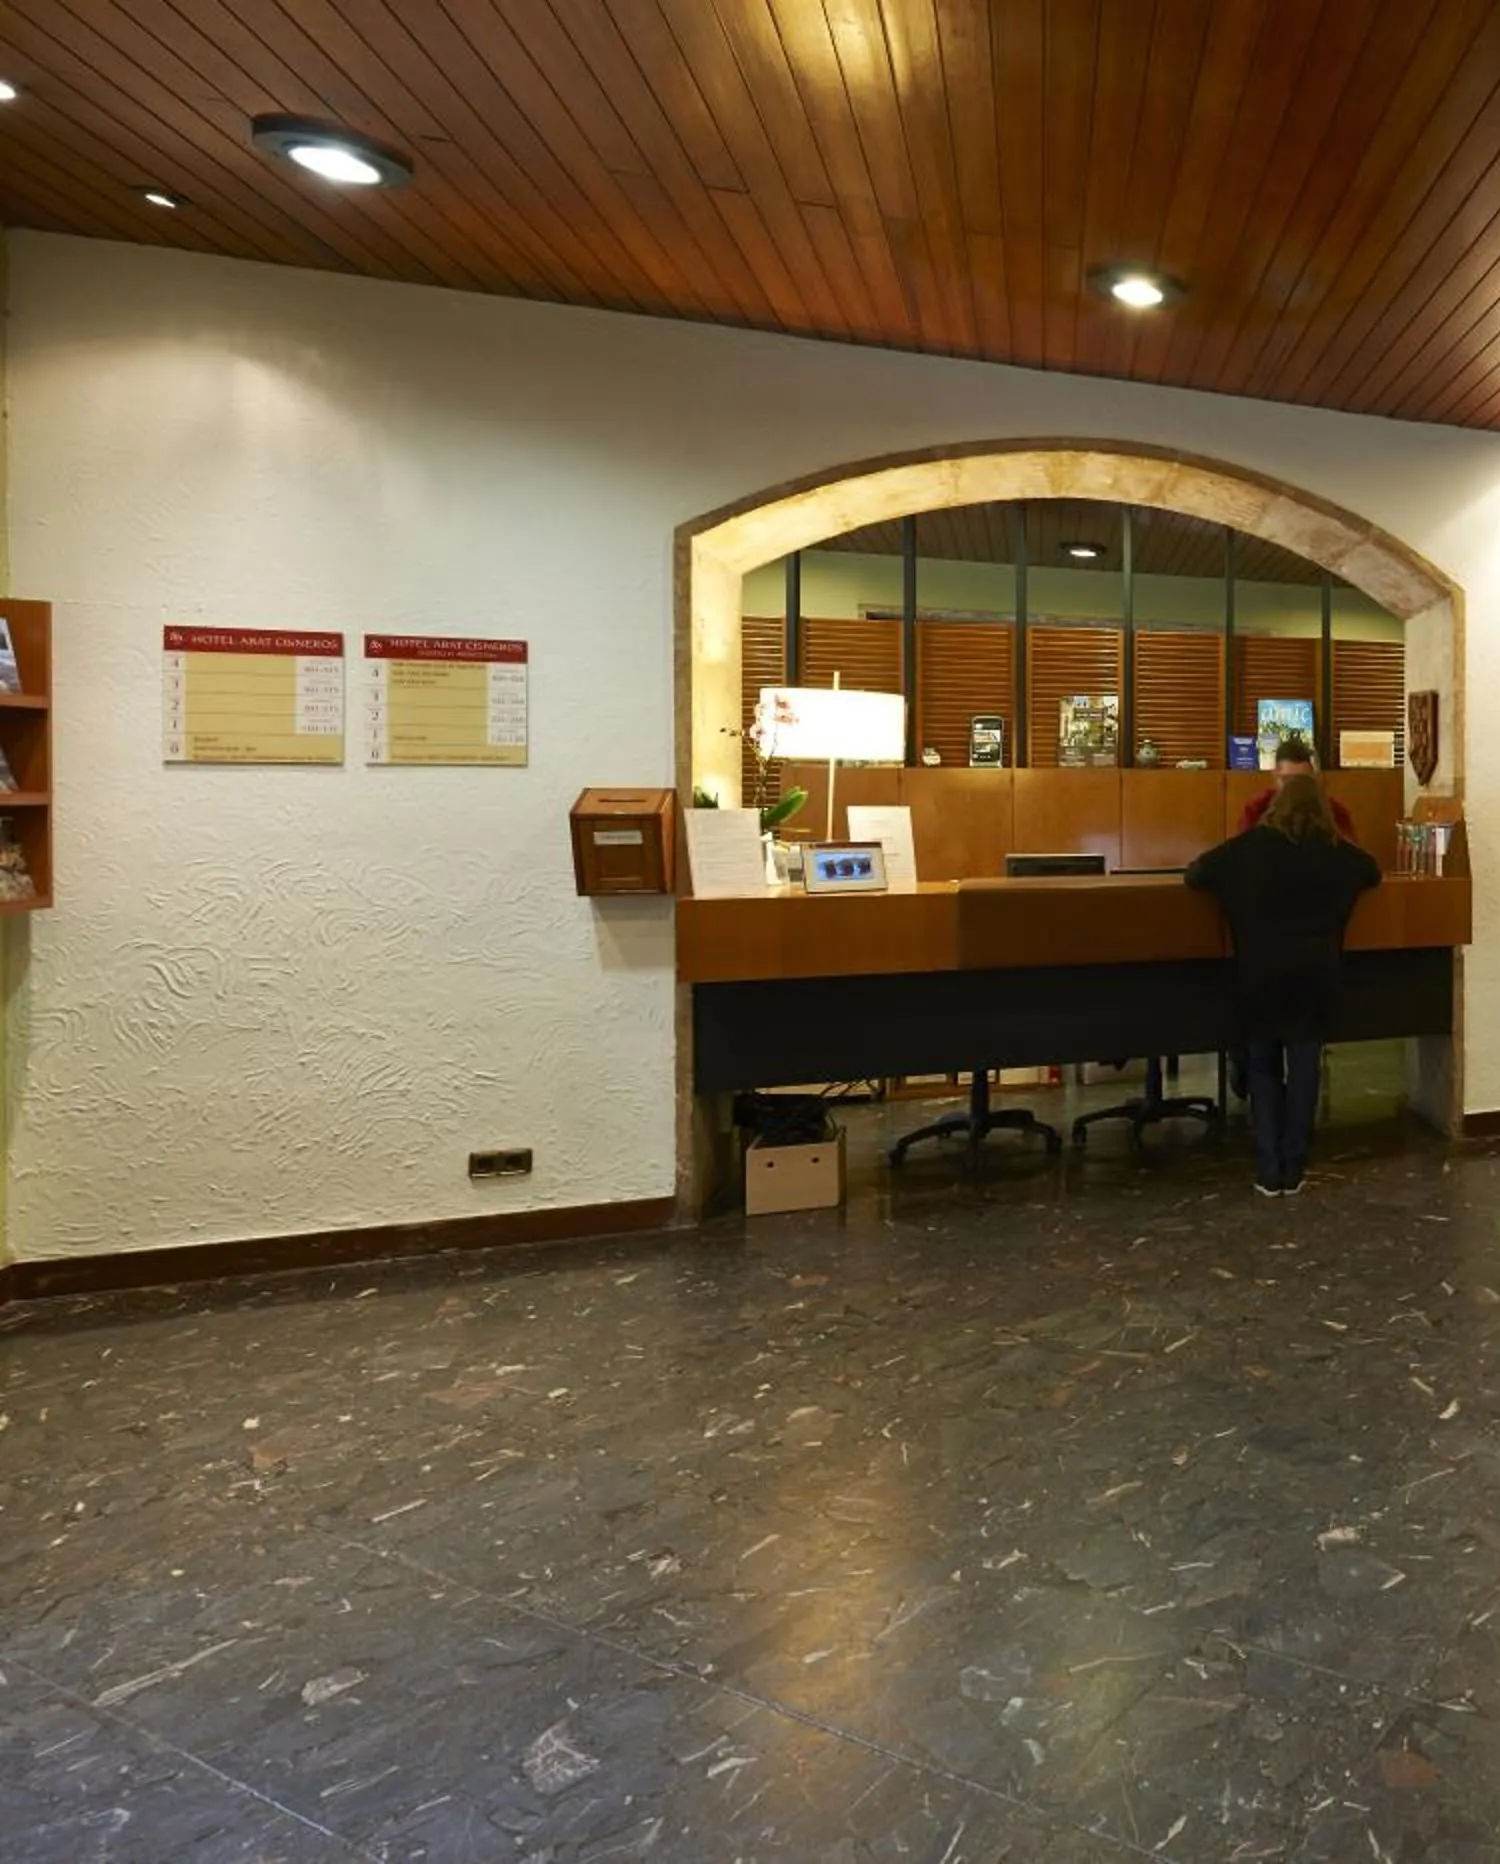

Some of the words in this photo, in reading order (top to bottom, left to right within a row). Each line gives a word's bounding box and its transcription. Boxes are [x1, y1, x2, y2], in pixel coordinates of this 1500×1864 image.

[191, 635, 233, 646] HOTEL
[240, 637, 271, 647] ABAT
[275, 638, 338, 650] CISNEROS
[390, 639, 429, 649] HOTEL
